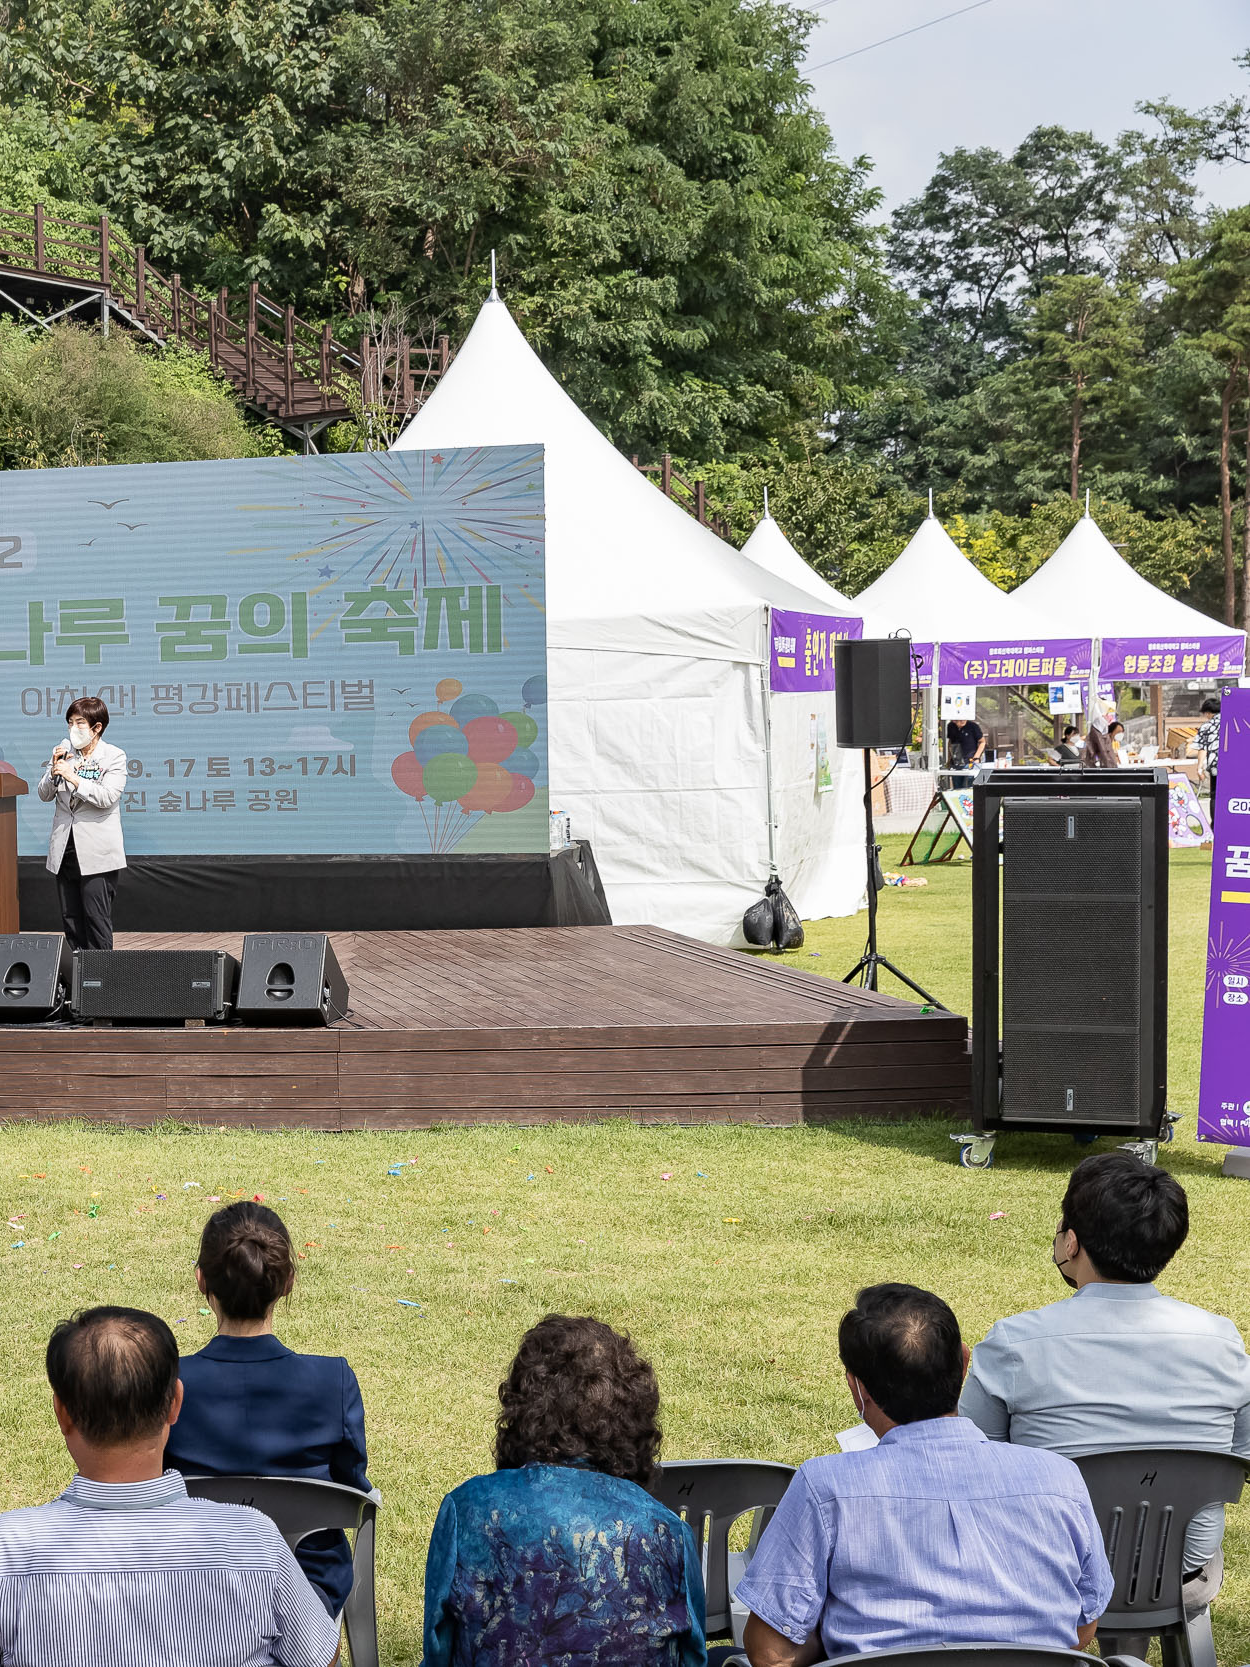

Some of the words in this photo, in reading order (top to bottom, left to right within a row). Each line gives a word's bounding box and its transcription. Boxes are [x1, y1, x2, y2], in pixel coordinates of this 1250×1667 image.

[155, 592, 308, 662] 꿈의
[340, 584, 502, 655] 축제
[963, 657, 1067, 679] (주)그레이트퍼즐
[1124, 654, 1176, 674] 협동조합
[150, 679, 375, 715] 평강페스티벌
[164, 758, 196, 778] 17
[206, 756, 231, 777] 토
[243, 754, 356, 777] 13~17시
[119, 791, 147, 812] 진
[158, 790, 236, 812] 숲나루
[247, 789, 299, 812] 공원
[1232, 801, 1250, 812] 20
[1227, 976, 1244, 986] 일시
[1227, 993, 1244, 1003] 장소
[678, 1481, 695, 1496] H
[1140, 1471, 1158, 1486] H
